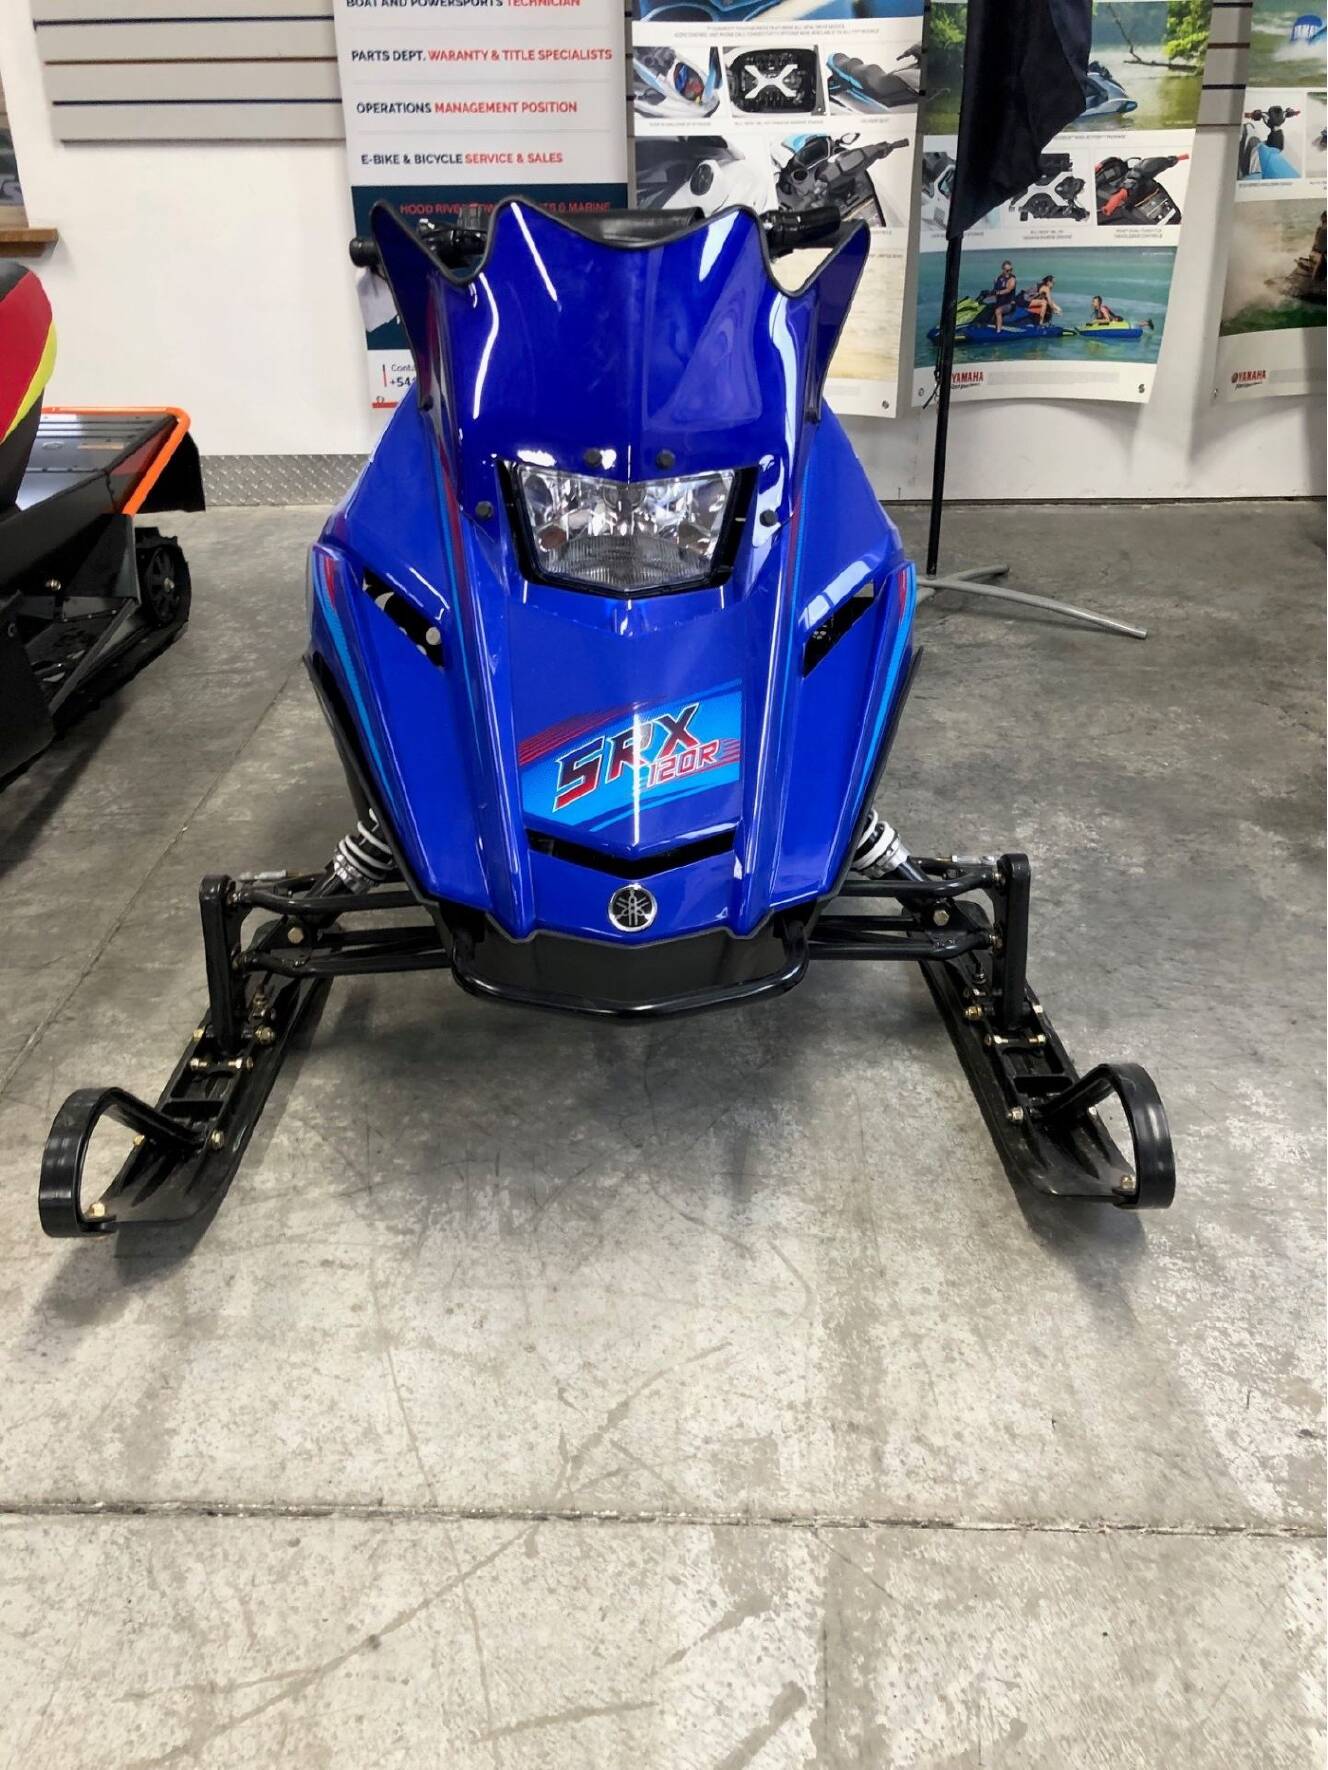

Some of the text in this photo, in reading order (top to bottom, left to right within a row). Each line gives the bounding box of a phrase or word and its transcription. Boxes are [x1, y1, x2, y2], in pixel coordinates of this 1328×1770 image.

[351, 49, 612, 61] PARTS DEPT. WARANTY & TITLE SPECIALISTS
[356, 101, 577, 114] OPERATIONS MANAGEMENT POSITION
[361, 152, 563, 165] E-BIKE & BICYCLE SERVICE & SALES
[400, 204, 433, 214] HOOD
[435, 203, 464, 214] RIVE
[951, 371, 984, 383] YAMAHA
[552, 702, 700, 813] SRX
[647, 739, 720, 788] 120R
